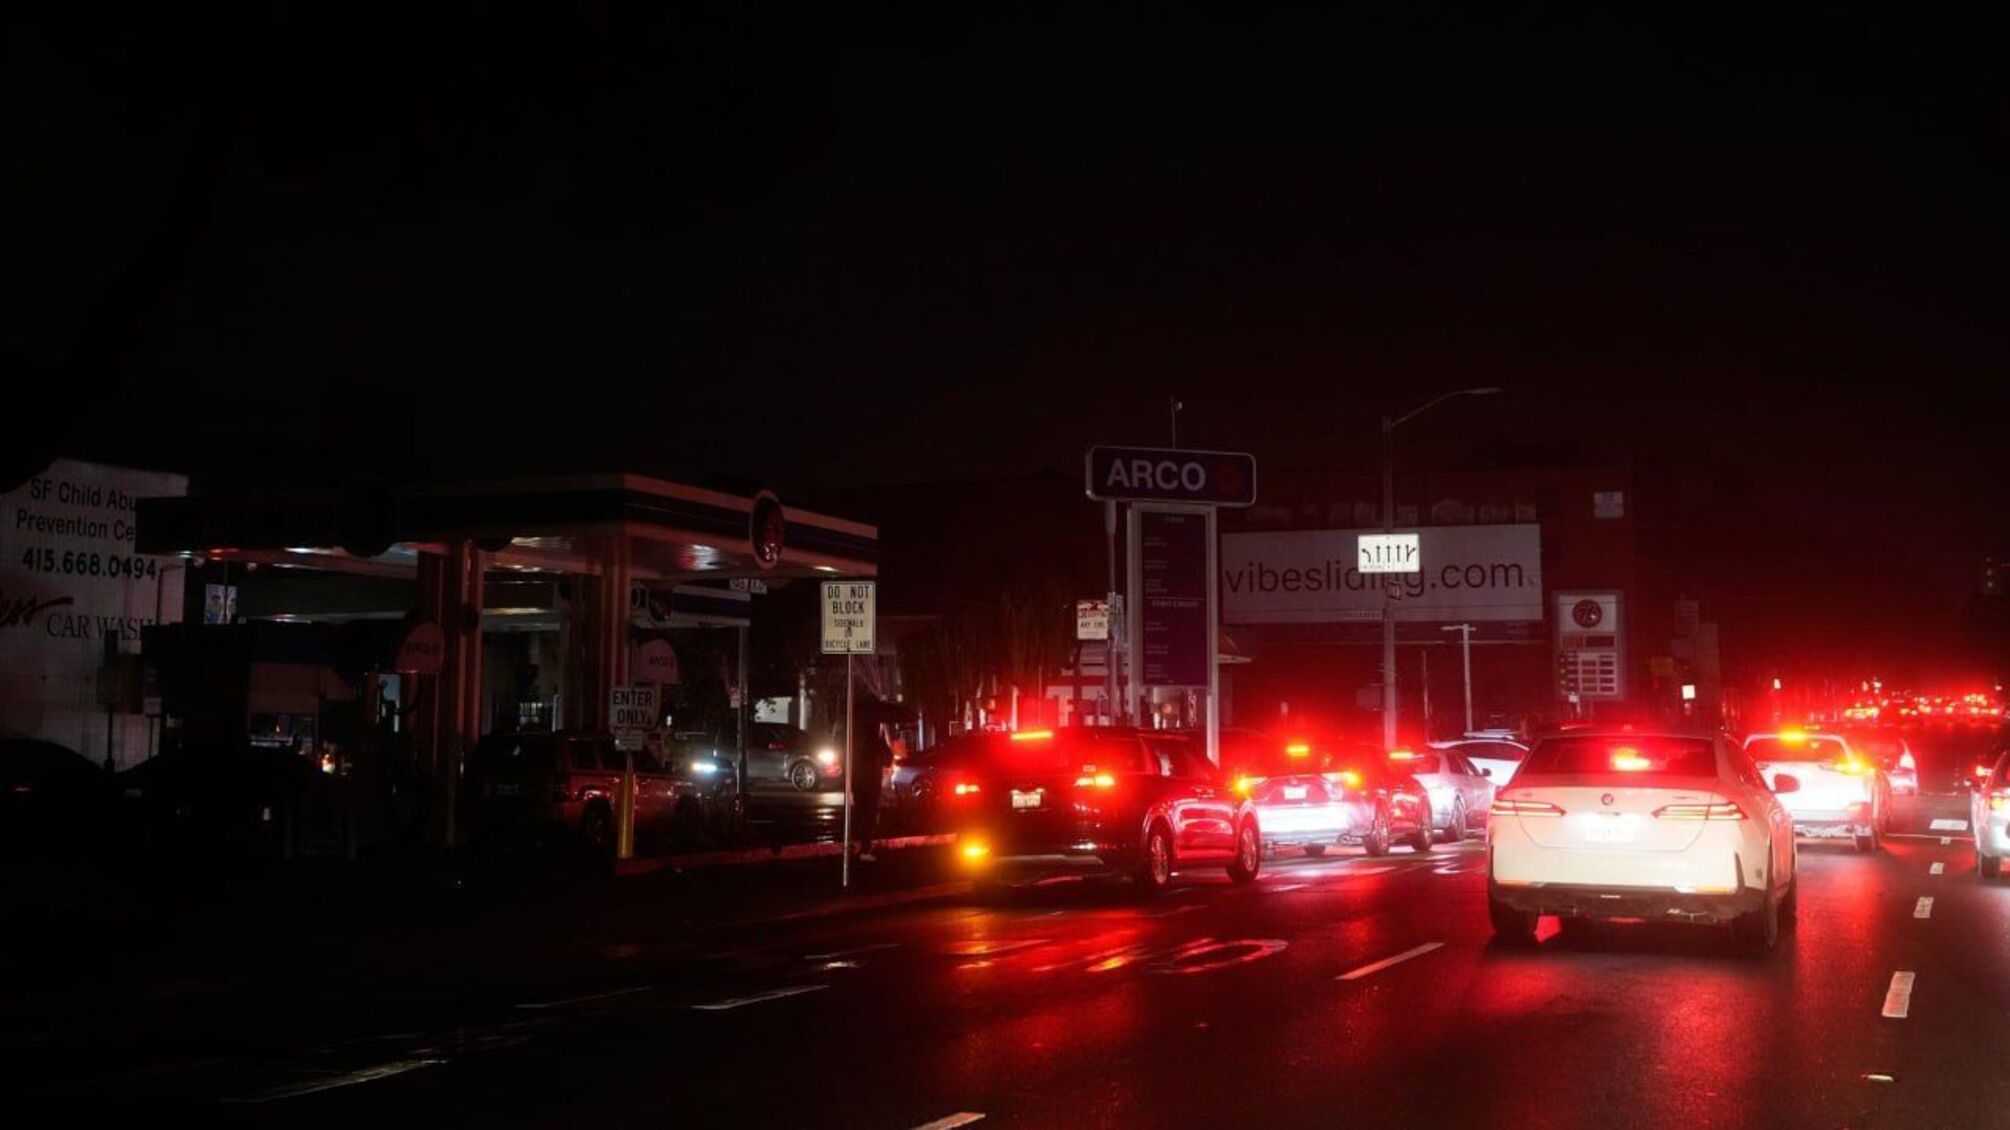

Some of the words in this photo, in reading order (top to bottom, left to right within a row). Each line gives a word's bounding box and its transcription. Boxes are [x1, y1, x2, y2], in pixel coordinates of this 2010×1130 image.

[1106, 458, 1207, 491] ARCO
[31, 478, 52, 500] SF
[58, 481, 101, 507] Child
[16, 508, 107, 539] Prevention
[22, 546, 157, 579] 415.668.0494
[827, 586, 840, 598] DO
[850, 586, 869, 598] NOT
[832, 601, 865, 614] BLOCK
[46, 614, 91, 638] CAR
[613, 690, 652, 706] ENTER
[616, 708, 648, 724] ONLY
